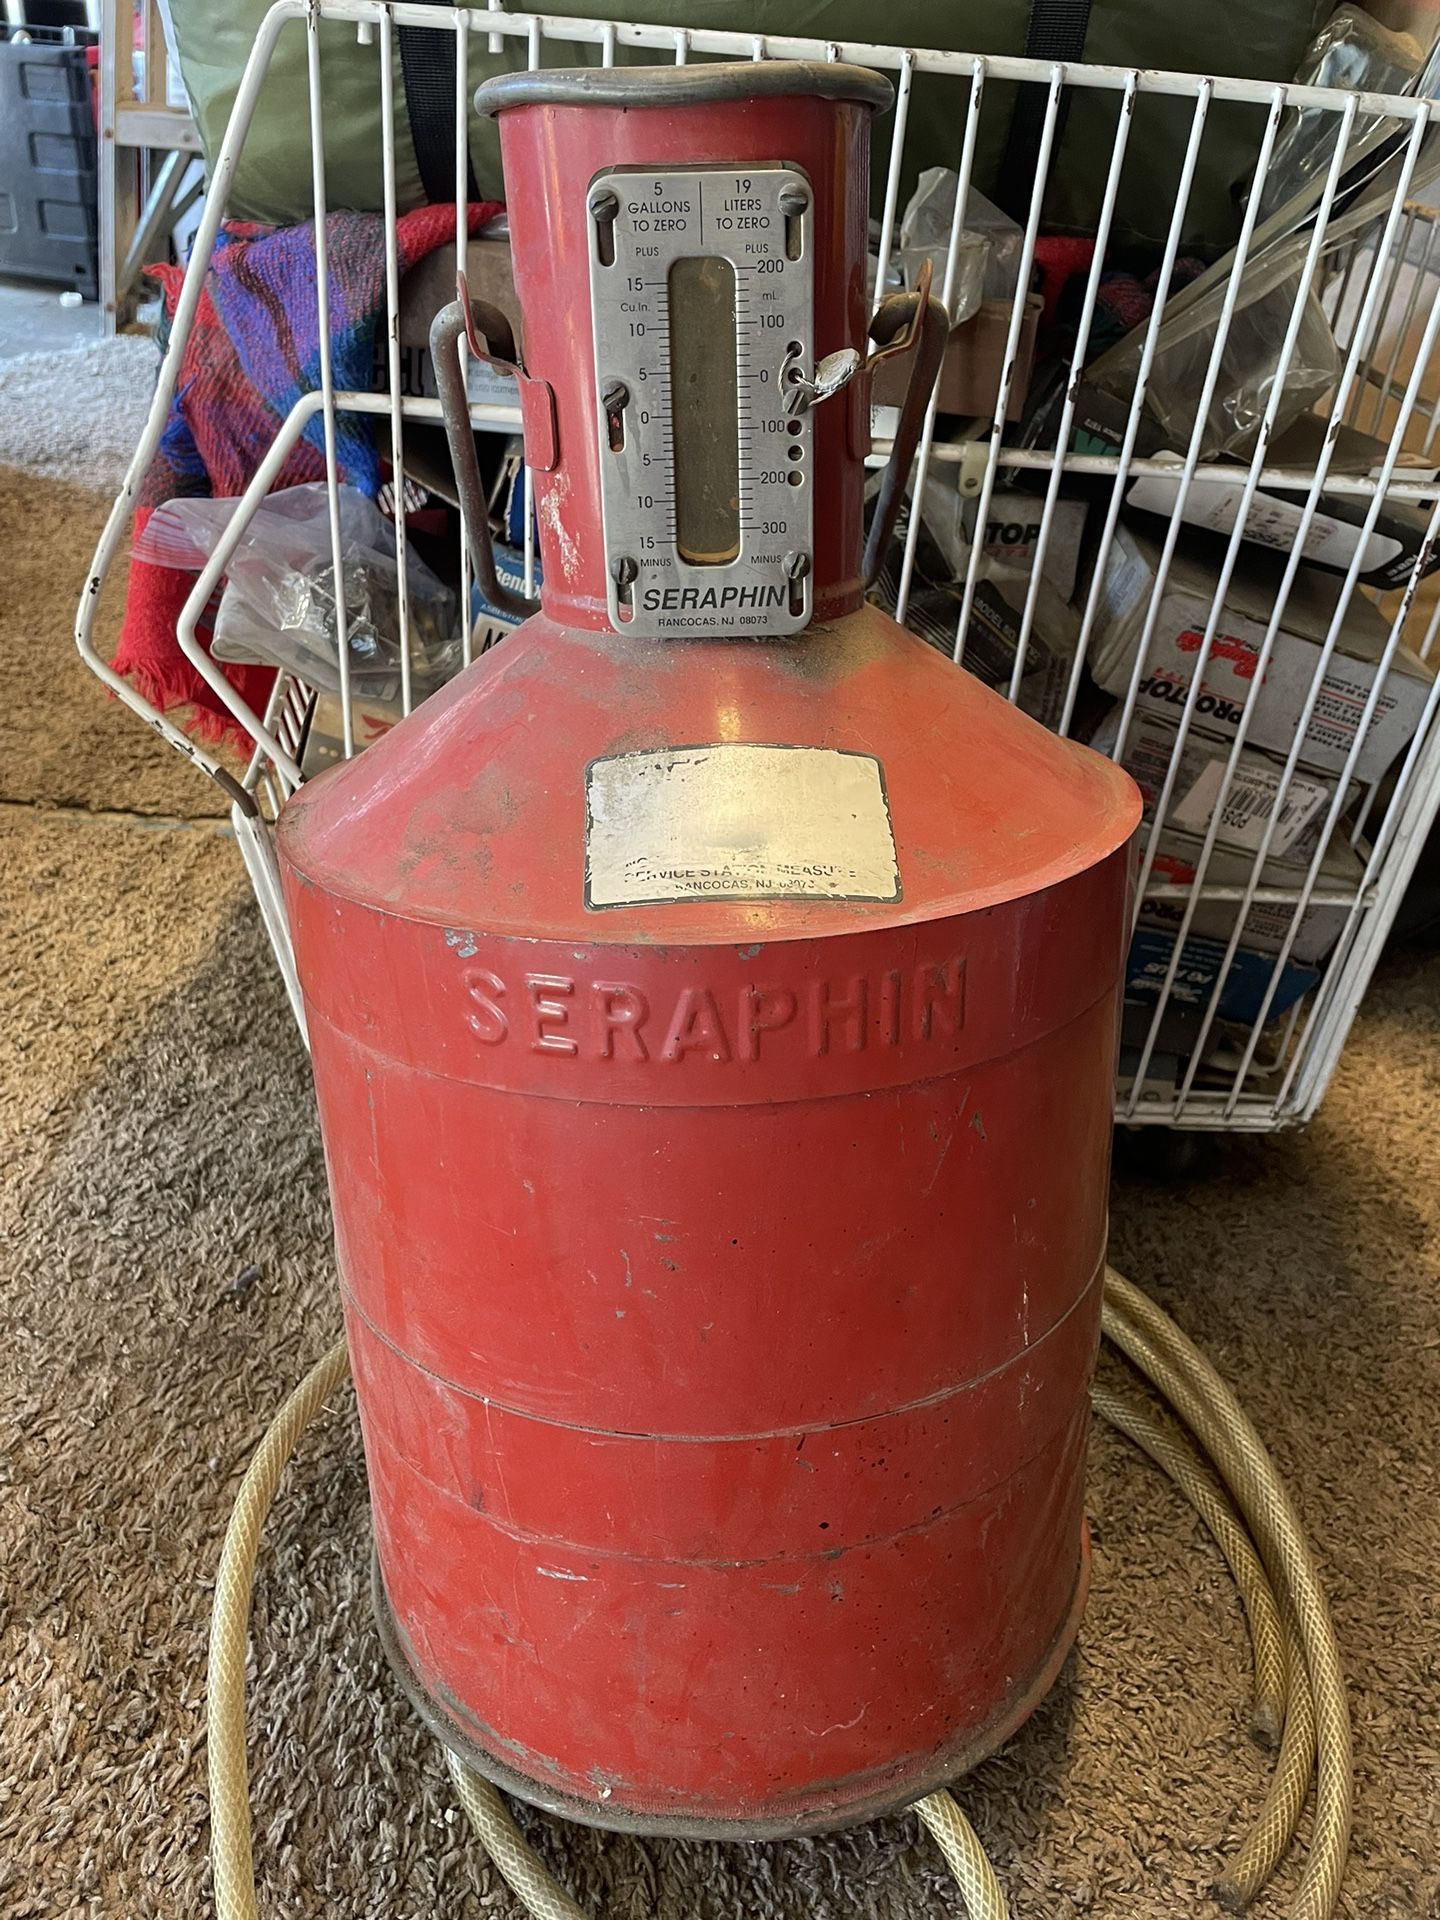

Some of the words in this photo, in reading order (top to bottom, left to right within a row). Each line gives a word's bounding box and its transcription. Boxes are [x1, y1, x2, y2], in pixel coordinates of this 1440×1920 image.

[654, 182, 663, 196] 5
[735, 179, 752, 194] 19
[627, 200, 691, 215] GALLONS
[724, 198, 762, 211] LITERS
[632, 219, 650, 232] TO
[653, 218, 687, 232] ZERO
[716, 217, 733, 230] TO
[737, 216, 771, 229] ZERO
[635, 246, 660, 257] PLUS
[745, 243, 769, 254] PLUS
[757, 259, 784, 273] 200
[626, 278, 643, 291] 15
[759, 315, 785, 328] 100
[629, 323, 645, 336] 10
[638, 367, 647, 381] 5
[760, 369, 769, 383] 0
[640, 410, 649, 424] 0
[760, 420, 785, 433] 100
[642, 453, 651, 467] 5
[760, 471, 786, 485] 200
[637, 496, 653, 509] 10
[761, 521, 787, 534] 300
[639, 536, 655, 550] 15
[640, 557, 672, 567] MINUS
[750, 554, 782, 565] MINUS
[495, 564, 542, 600] Benx
[642, 584, 787, 611] SERAPHIN
[721, 616, 735, 625] NJ
[739, 615, 768, 625] 08073
[1138, 677, 1244, 724] PROTOP
[776, 864, 857, 877] MEASUE
[756, 879, 772, 889] NJ
[461, 956, 969, 1064] SERAPHIN
